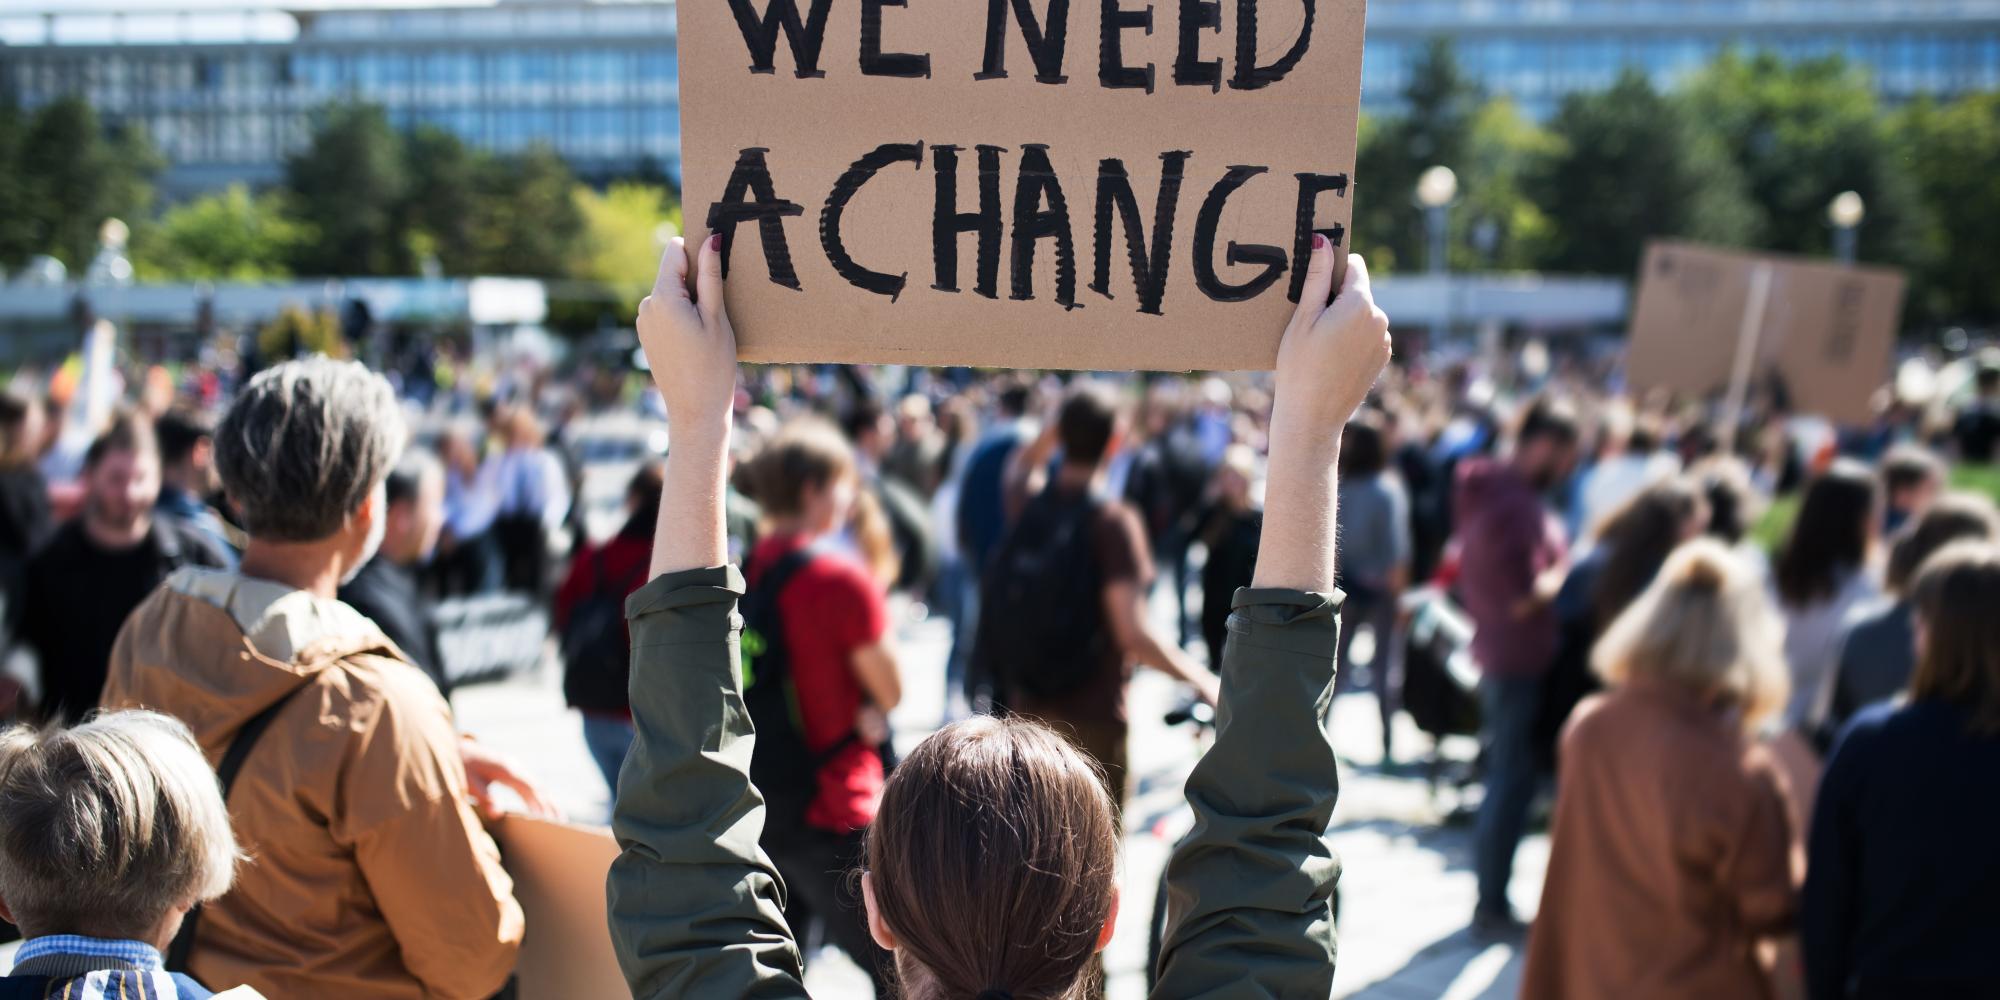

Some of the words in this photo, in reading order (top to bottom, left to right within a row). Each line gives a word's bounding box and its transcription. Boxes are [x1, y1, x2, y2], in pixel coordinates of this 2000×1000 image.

[727, 0, 932, 80] WE
[973, 0, 1316, 96] NEED
[706, 147, 804, 291] A
[819, 140, 1349, 316] CHANGE
